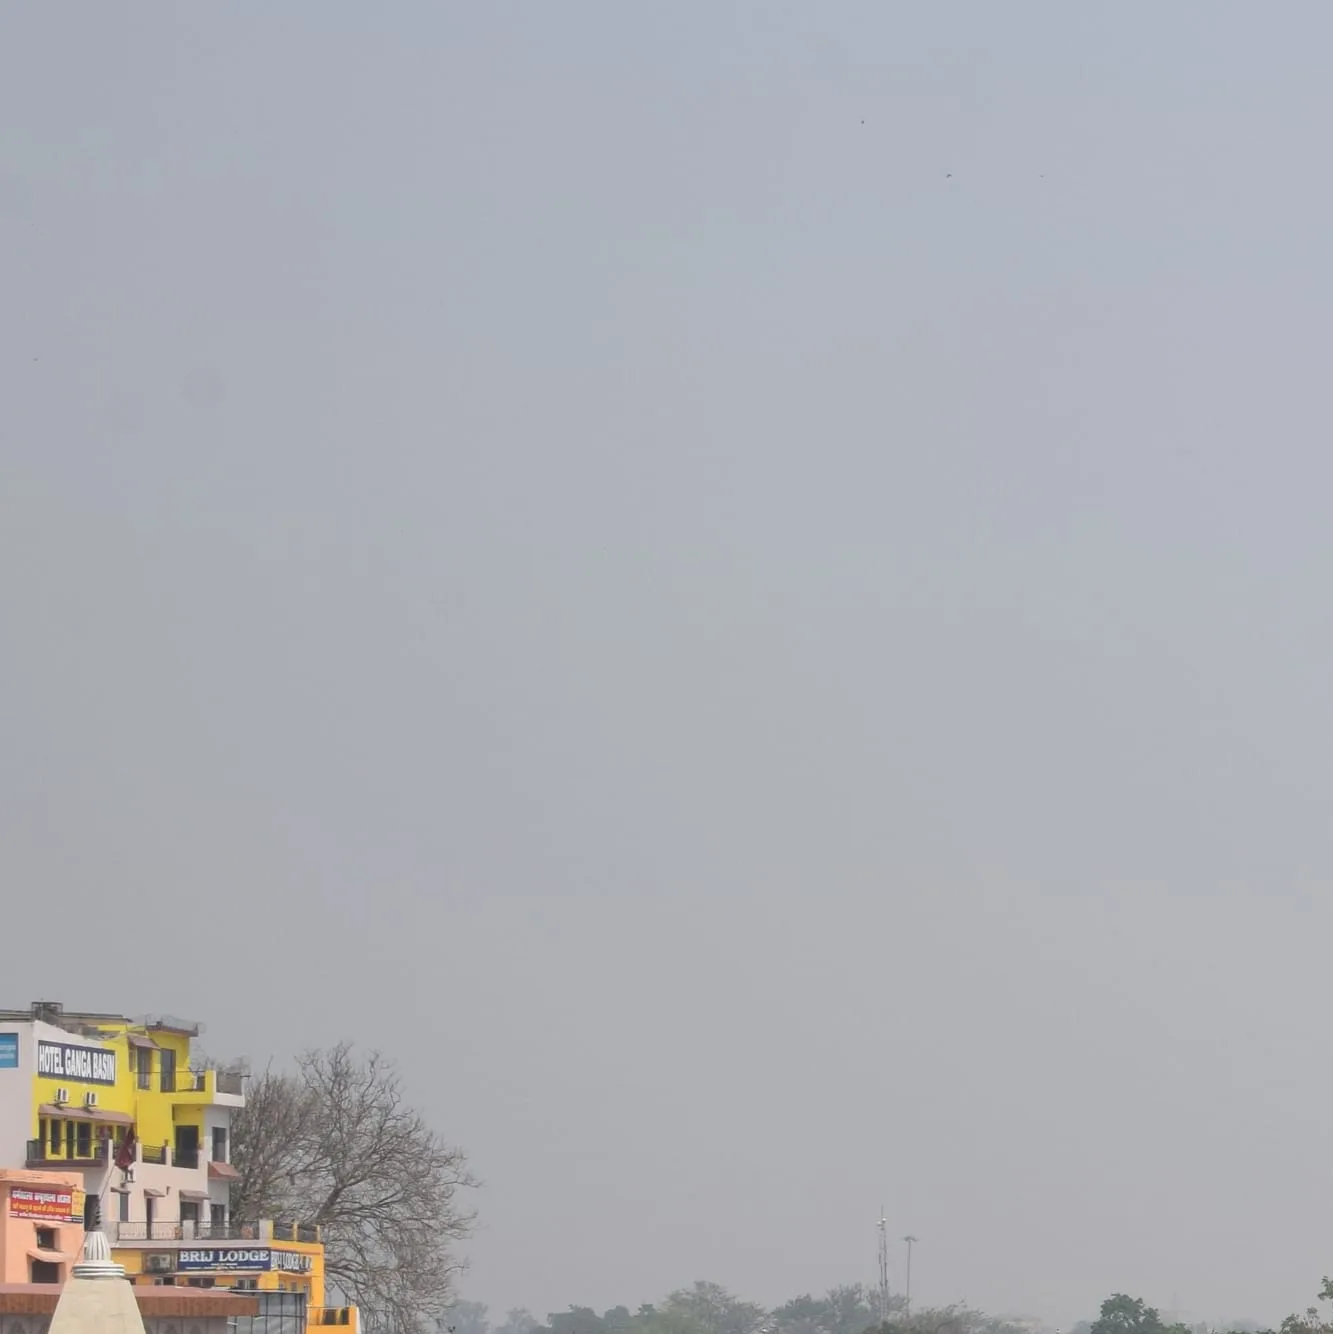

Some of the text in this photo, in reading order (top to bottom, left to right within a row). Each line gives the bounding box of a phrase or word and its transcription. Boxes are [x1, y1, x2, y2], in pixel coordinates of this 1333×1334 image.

[39, 1045, 64, 1074] HOTEL
[65, 1048, 92, 1079] GANGA
[92, 1053, 115, 1081] BASIN
[179, 1249, 270, 1263] BRIJ LODGE
